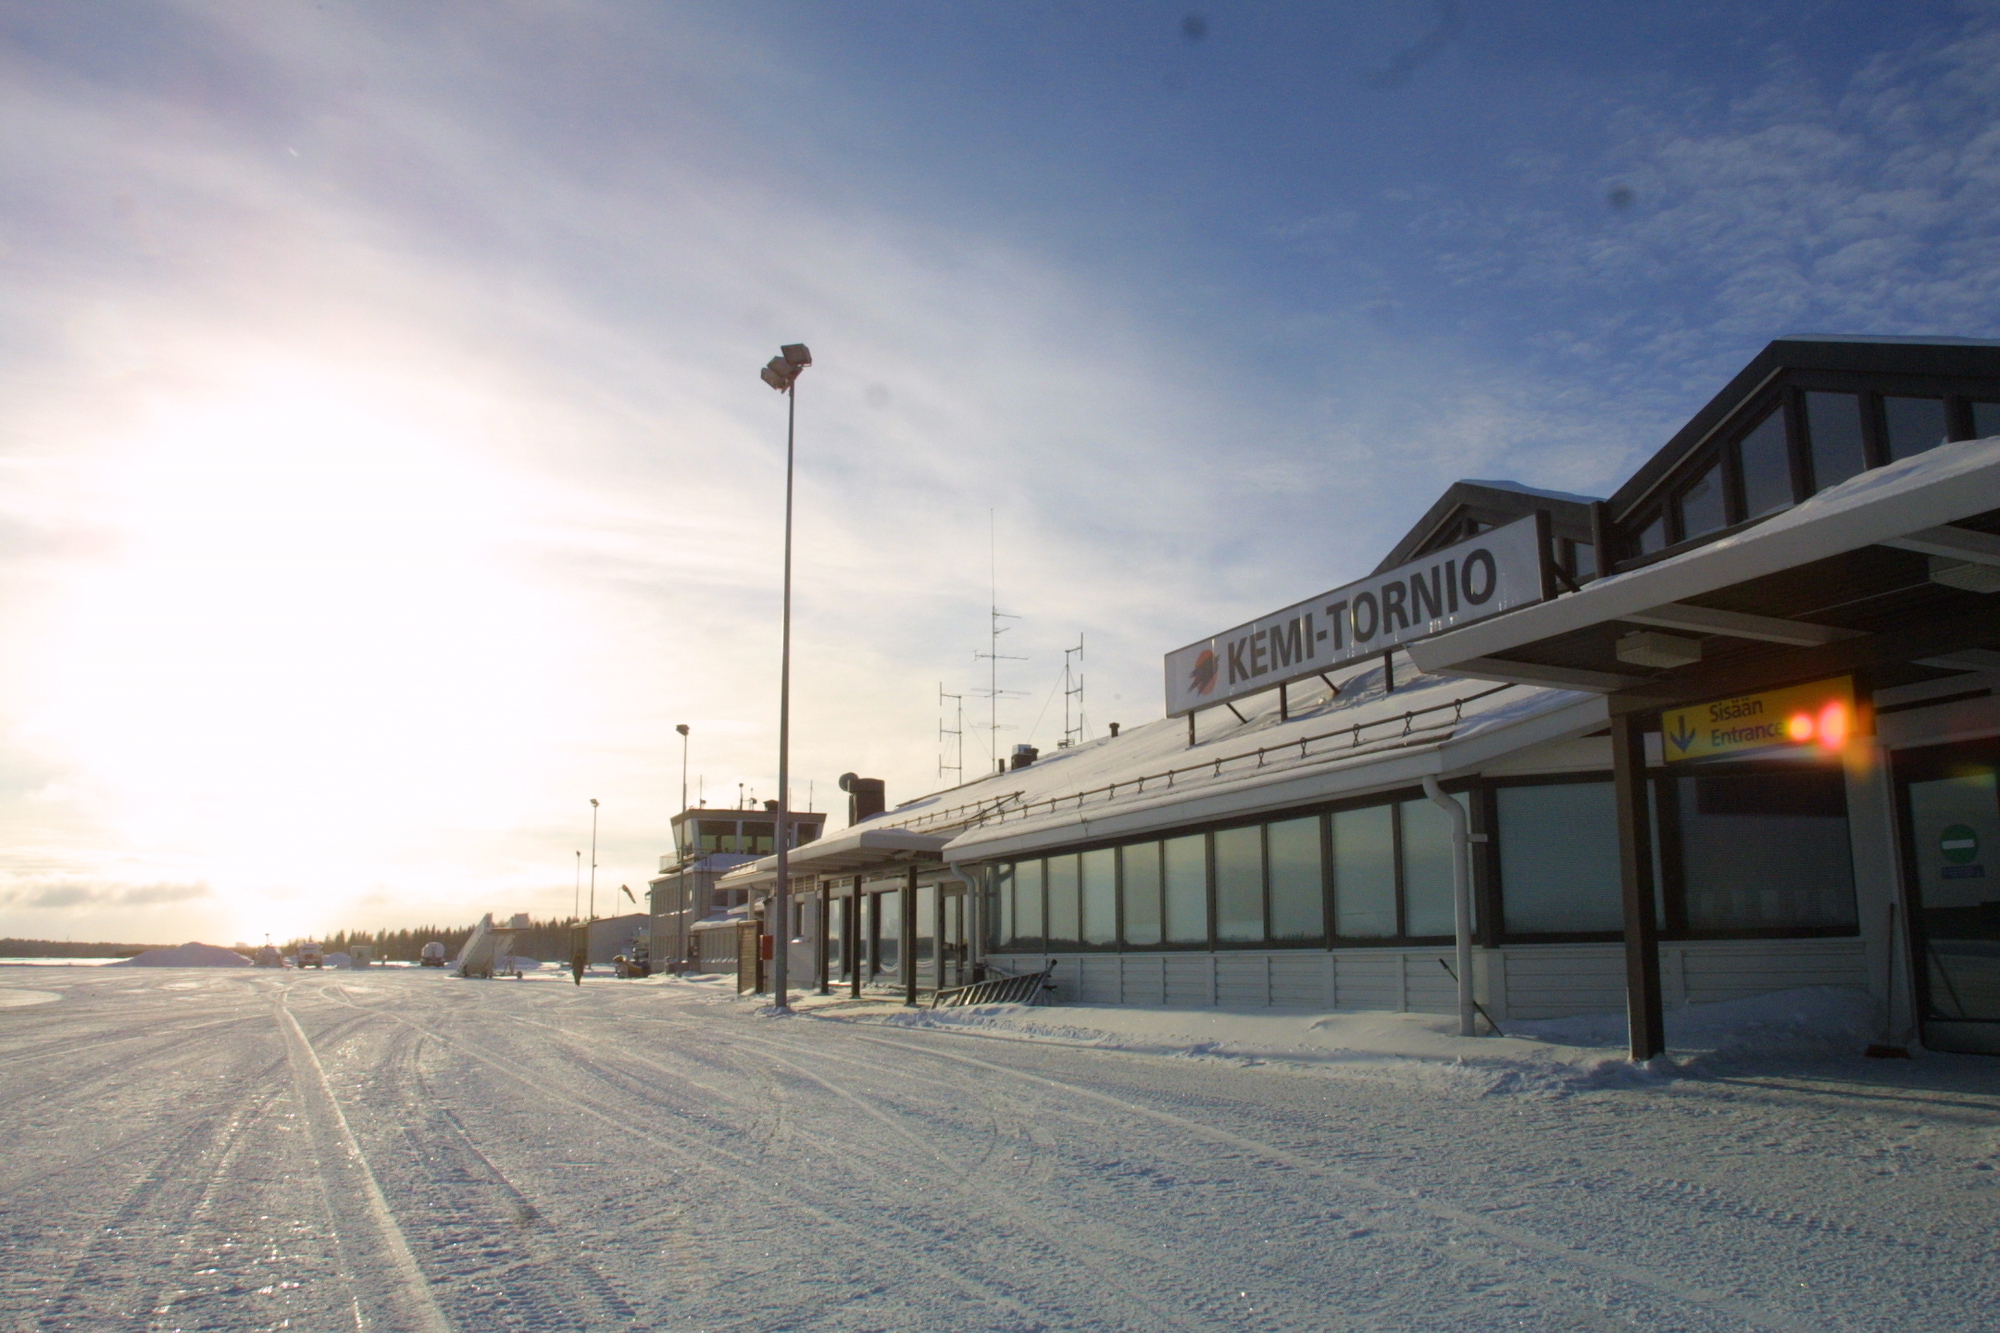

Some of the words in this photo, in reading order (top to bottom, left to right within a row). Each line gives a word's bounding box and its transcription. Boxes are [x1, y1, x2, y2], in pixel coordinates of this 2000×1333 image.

[1227, 548, 1497, 685] KEMI-TORNIO
[1709, 697, 1763, 722] Sisään
[1711, 721, 1784, 746] Entrance
